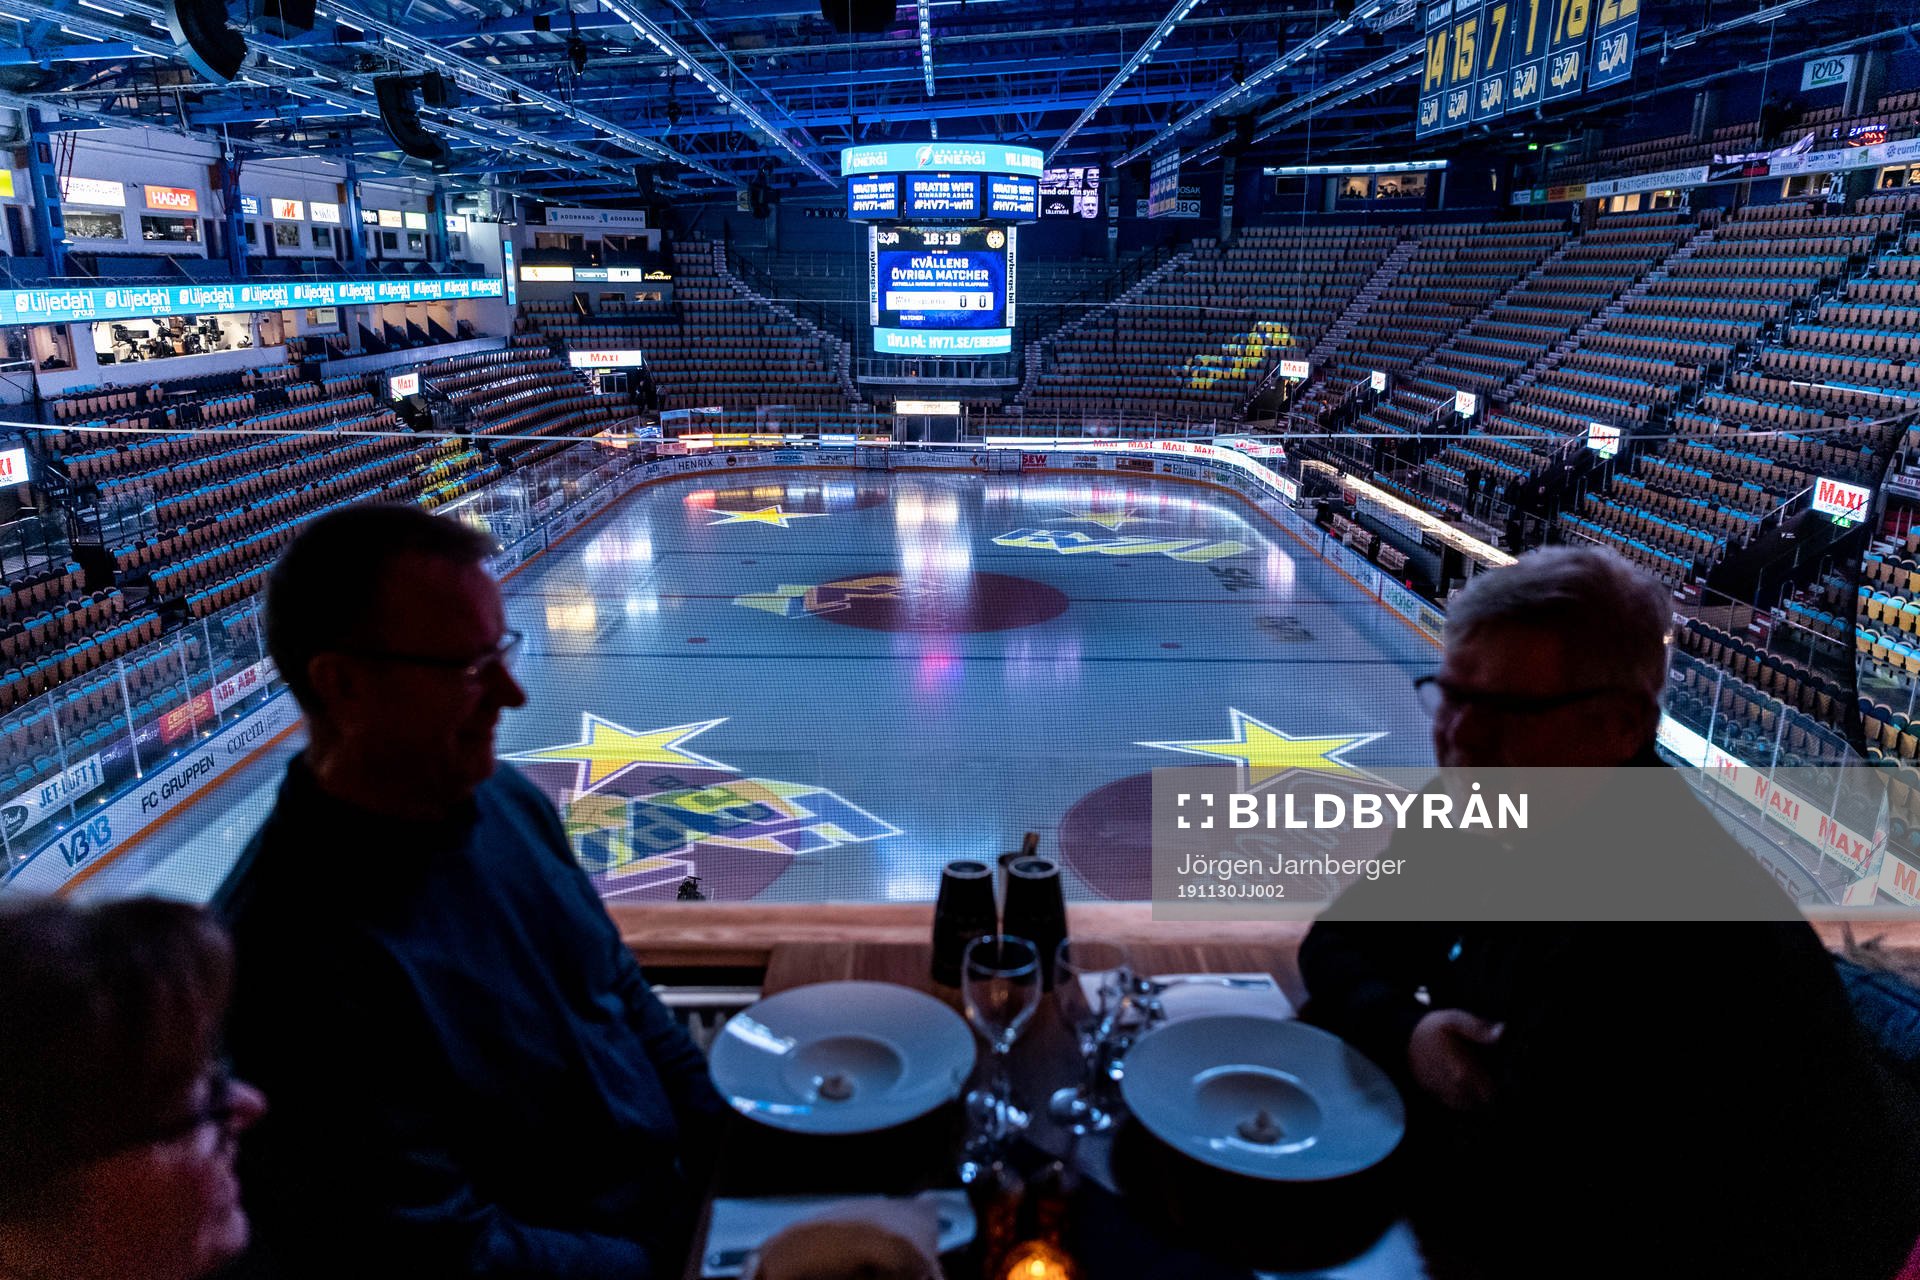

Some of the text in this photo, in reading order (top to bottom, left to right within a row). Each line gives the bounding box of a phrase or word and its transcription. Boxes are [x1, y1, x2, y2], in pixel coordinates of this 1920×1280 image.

[1487, 5, 1507, 70] 7
[1452, 18, 1477, 83] 15
[1424, 30, 1447, 92] 14
[935, 154, 985, 165] ENERGI
[913, 182, 974, 193] GRATIS WIFI
[152, 192, 190, 206] HAGAB
[911, 256, 969, 269] KVÄLLENS
[891, 267, 989, 280] ÖVRIGA MATCHER
[30, 290, 95, 316] Liljedahl
[115, 288, 171, 311] Liljedahl
[189, 287, 234, 308] Liljedahl
[250, 285, 288, 305] Liljedahl
[72, 309, 95, 318] group
[590, 353, 619, 362] MAXI
[1162, 441, 1185, 452] MAXI
[678, 458, 714, 470] HENRIX
[1818, 481, 1863, 511] MAXI
[226, 719, 265, 756] corem
[141, 752, 215, 814] FC GRUPPEN
[1818, 816, 1873, 869] MAXI
